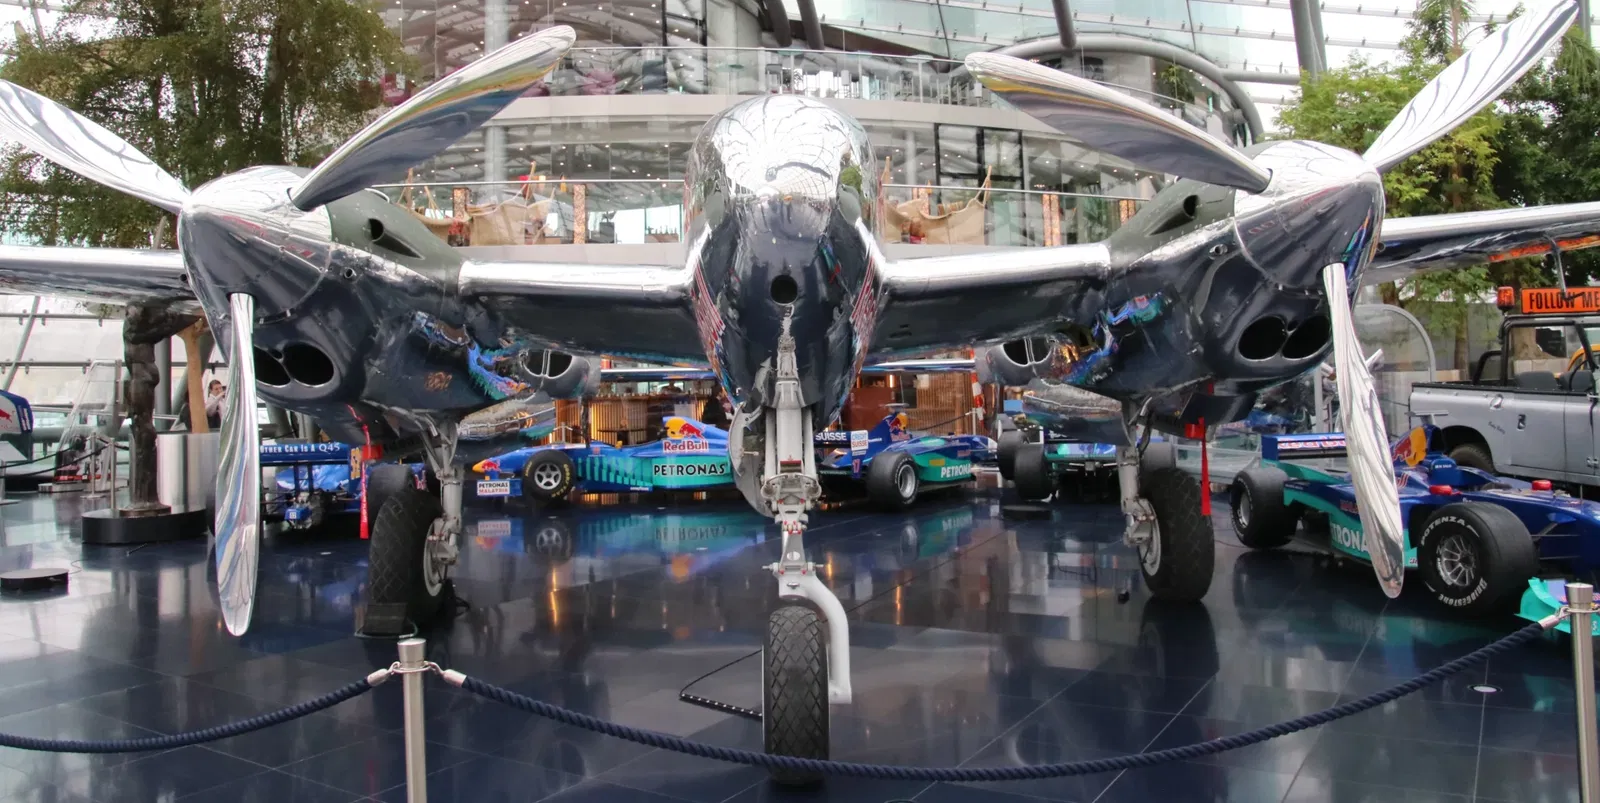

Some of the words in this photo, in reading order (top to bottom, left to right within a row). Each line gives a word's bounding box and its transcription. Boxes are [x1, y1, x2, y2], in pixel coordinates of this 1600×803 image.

[1529, 291, 1575, 309] FOLLOW
[1582, 292, 1600, 308] ME
[815, 432, 847, 441] SUISSE
[310, 444, 316, 452] A
[318, 442, 340, 452] Q45
[654, 463, 726, 475] PETRONAS
[852, 459, 861, 473] 17
[941, 464, 972, 478] PETRONA
[1330, 522, 1370, 552] TRONA
[1421, 516, 1465, 546] POTENZA
[1438, 577, 1488, 607] BRIDGESTONE
